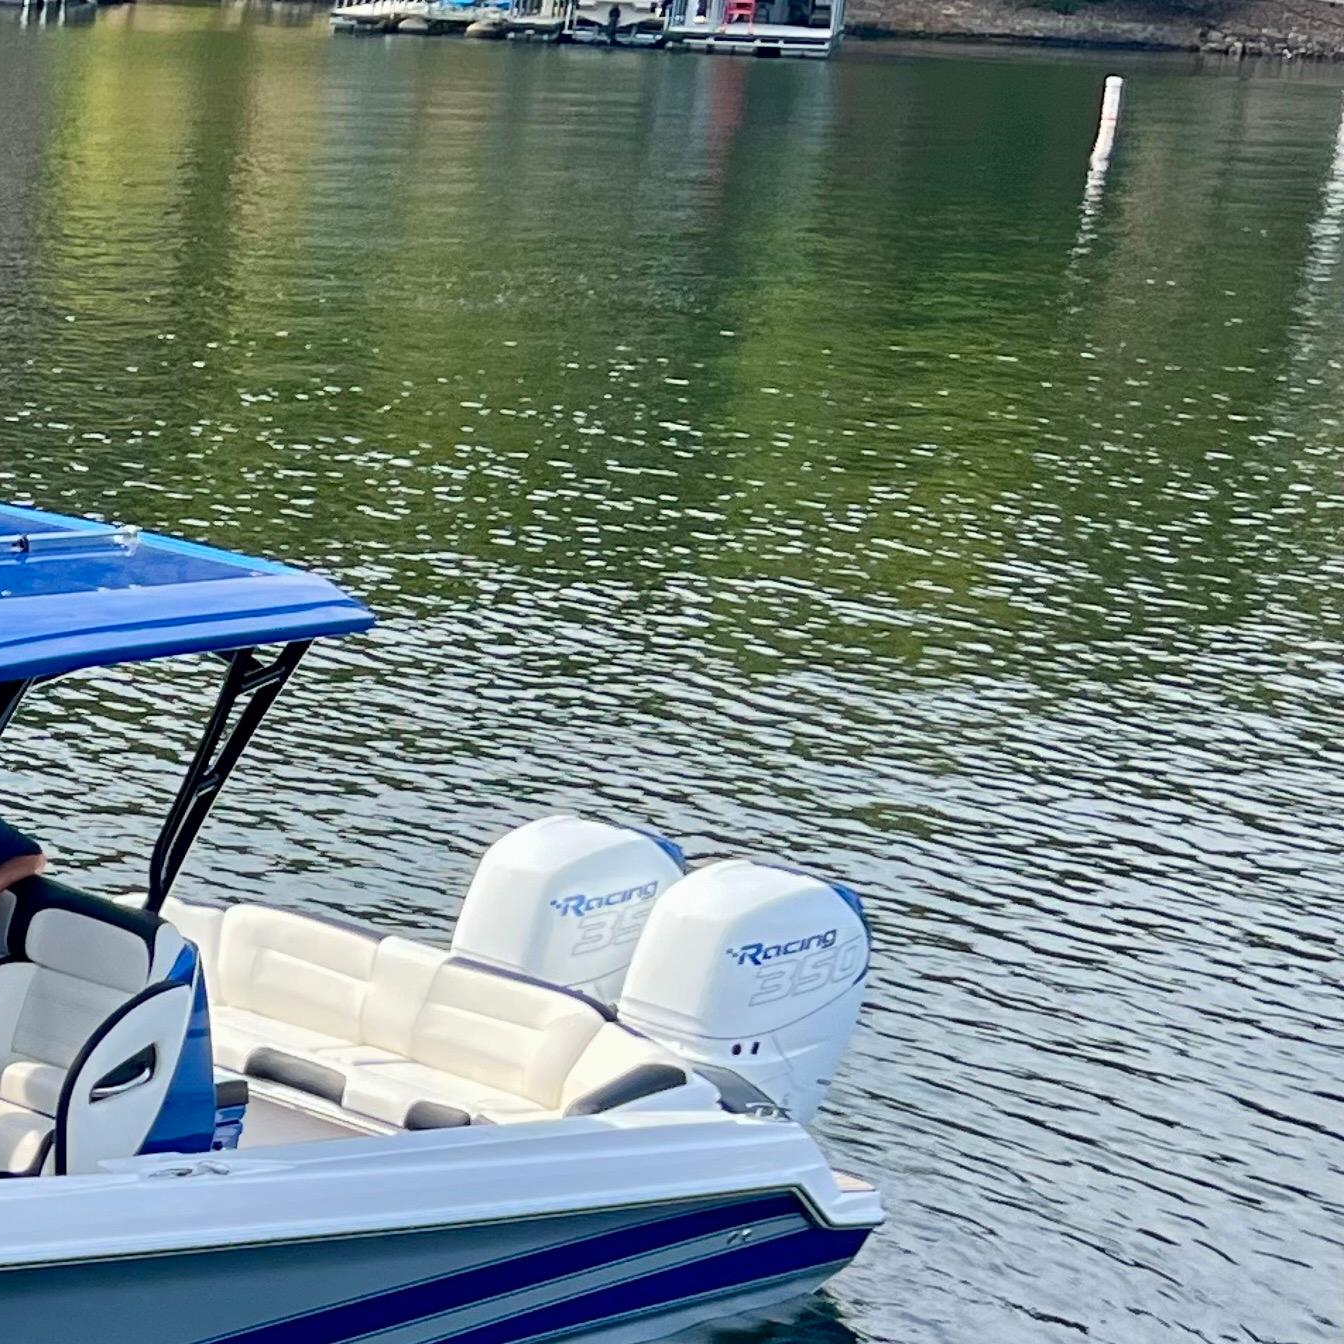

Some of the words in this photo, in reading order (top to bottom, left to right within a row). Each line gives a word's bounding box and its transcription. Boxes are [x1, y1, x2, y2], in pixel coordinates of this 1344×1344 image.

[560, 880, 659, 917] Racing
[570, 901, 653, 957] 35
[737, 928, 838, 966] Racing
[748, 933, 865, 1008] 350
